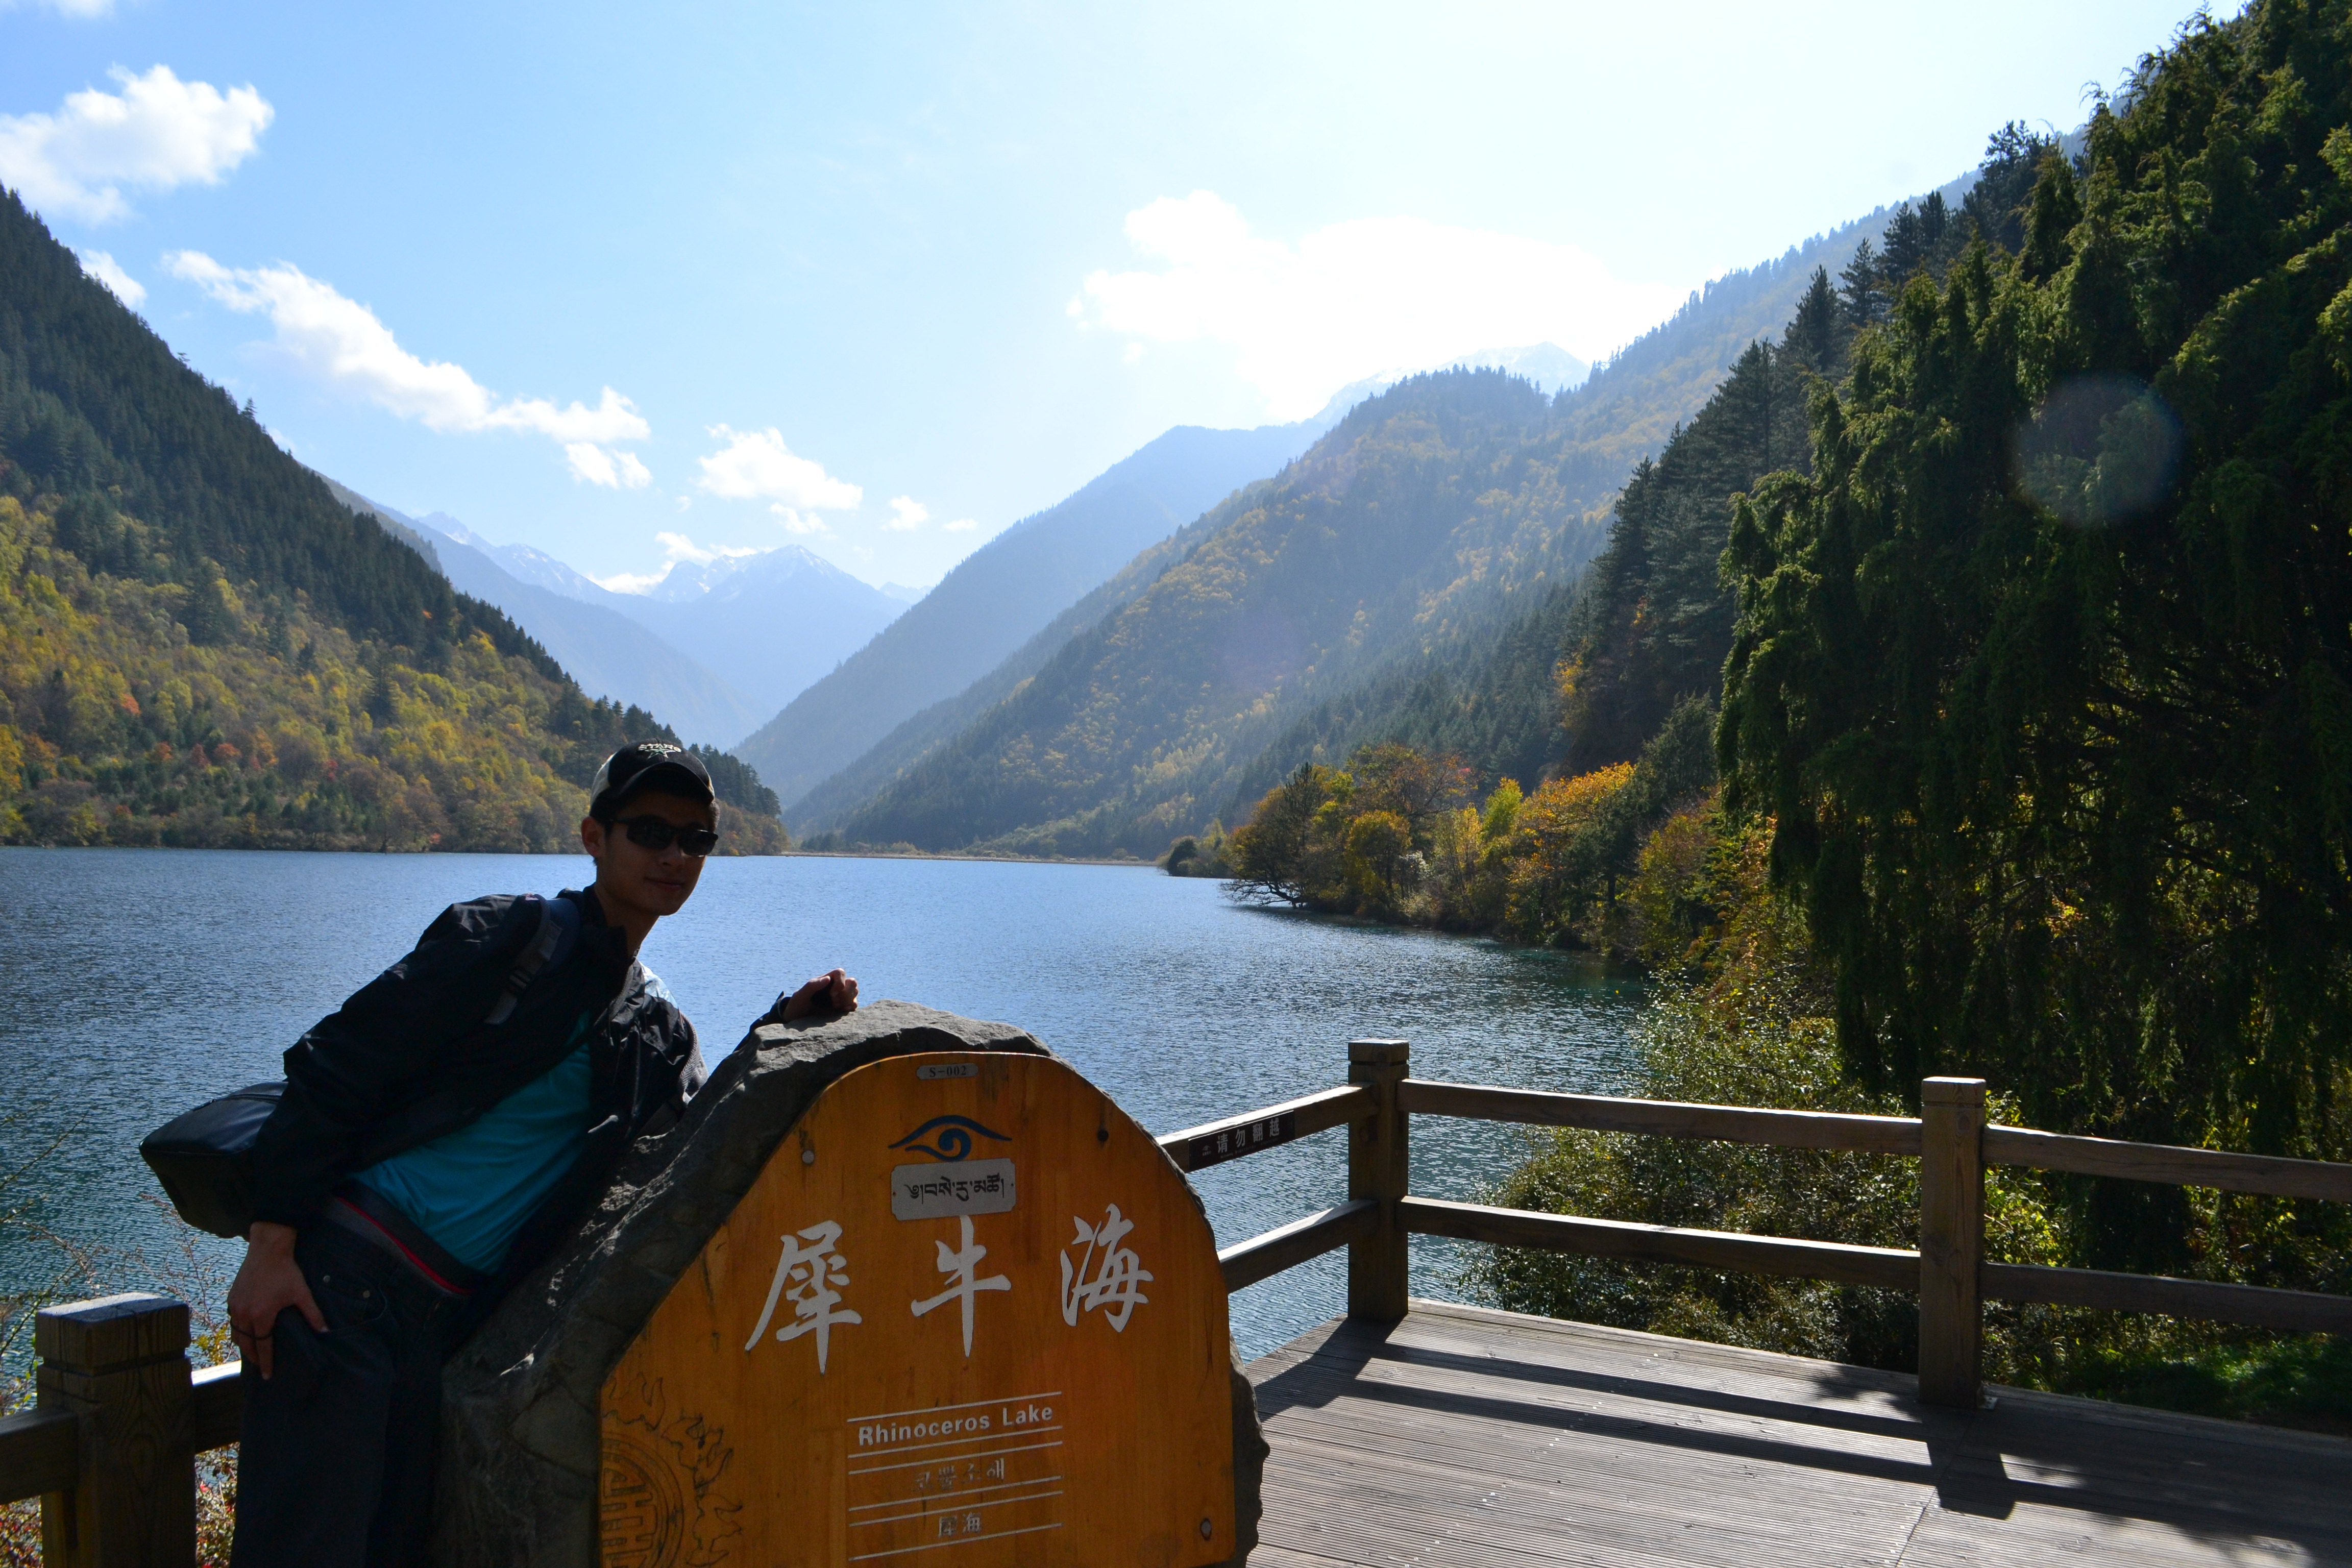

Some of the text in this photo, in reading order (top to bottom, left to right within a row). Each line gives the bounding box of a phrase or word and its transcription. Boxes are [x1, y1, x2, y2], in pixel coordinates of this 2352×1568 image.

[638, 743, 682, 753] STARS
[929, 1065, 967, 1077] S-002
[1216, 1117, 1280, 1154] 请勿翻越
[744, 1203, 1154, 1374] 犀牛海
[858, 1404, 1053, 1446] Rhinoceros Lake
